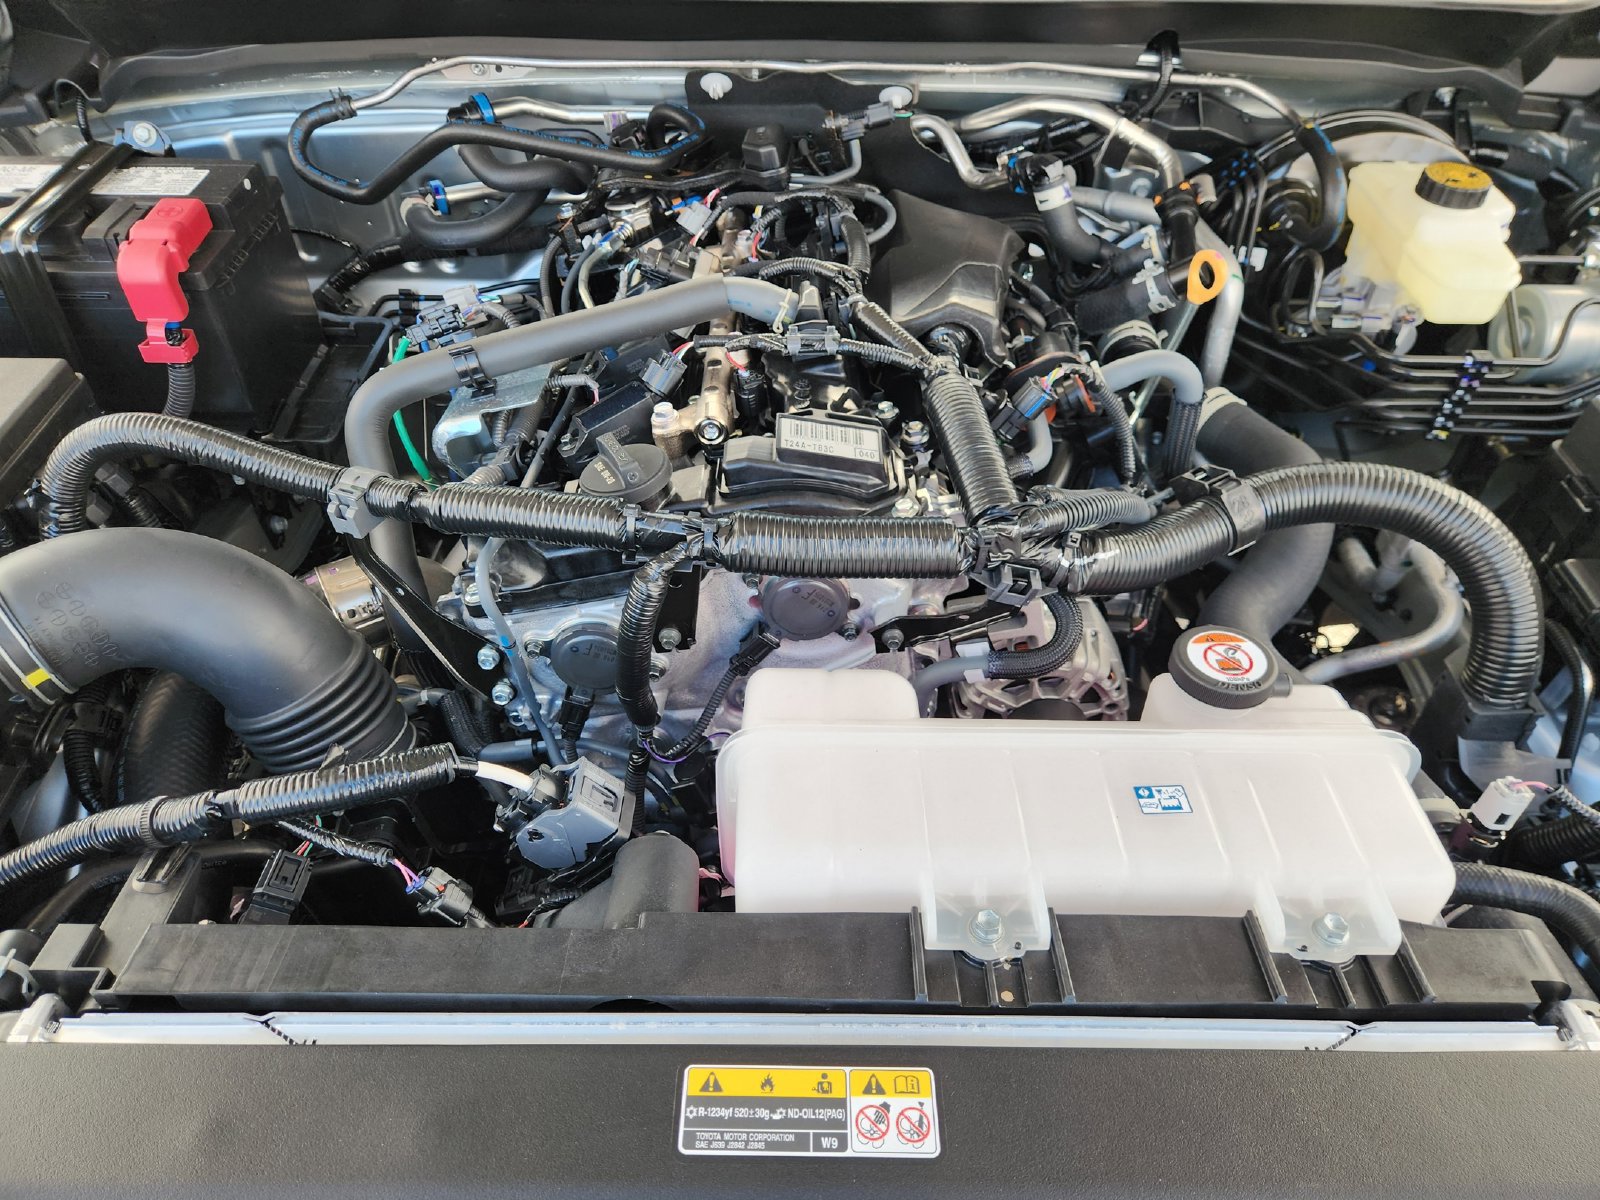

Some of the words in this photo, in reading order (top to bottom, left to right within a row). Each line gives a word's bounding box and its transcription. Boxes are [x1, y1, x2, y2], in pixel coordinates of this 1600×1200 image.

[1216, 680, 1262, 691] DENSO
[698, 1106, 733, 1119] R-1234yf
[734, 1107, 770, 1120] 520±30g
[787, 1107, 846, 1121] ND-OIL12(PAG)
[696, 1132, 721, 1140] TOYOTA
[723, 1133, 747, 1141] MOTOR
[749, 1133, 795, 1142] CORPORATION
[695, 1141, 709, 1149] SAE
[710, 1141, 726, 1149] J639
[821, 1137, 839, 1149] W9
